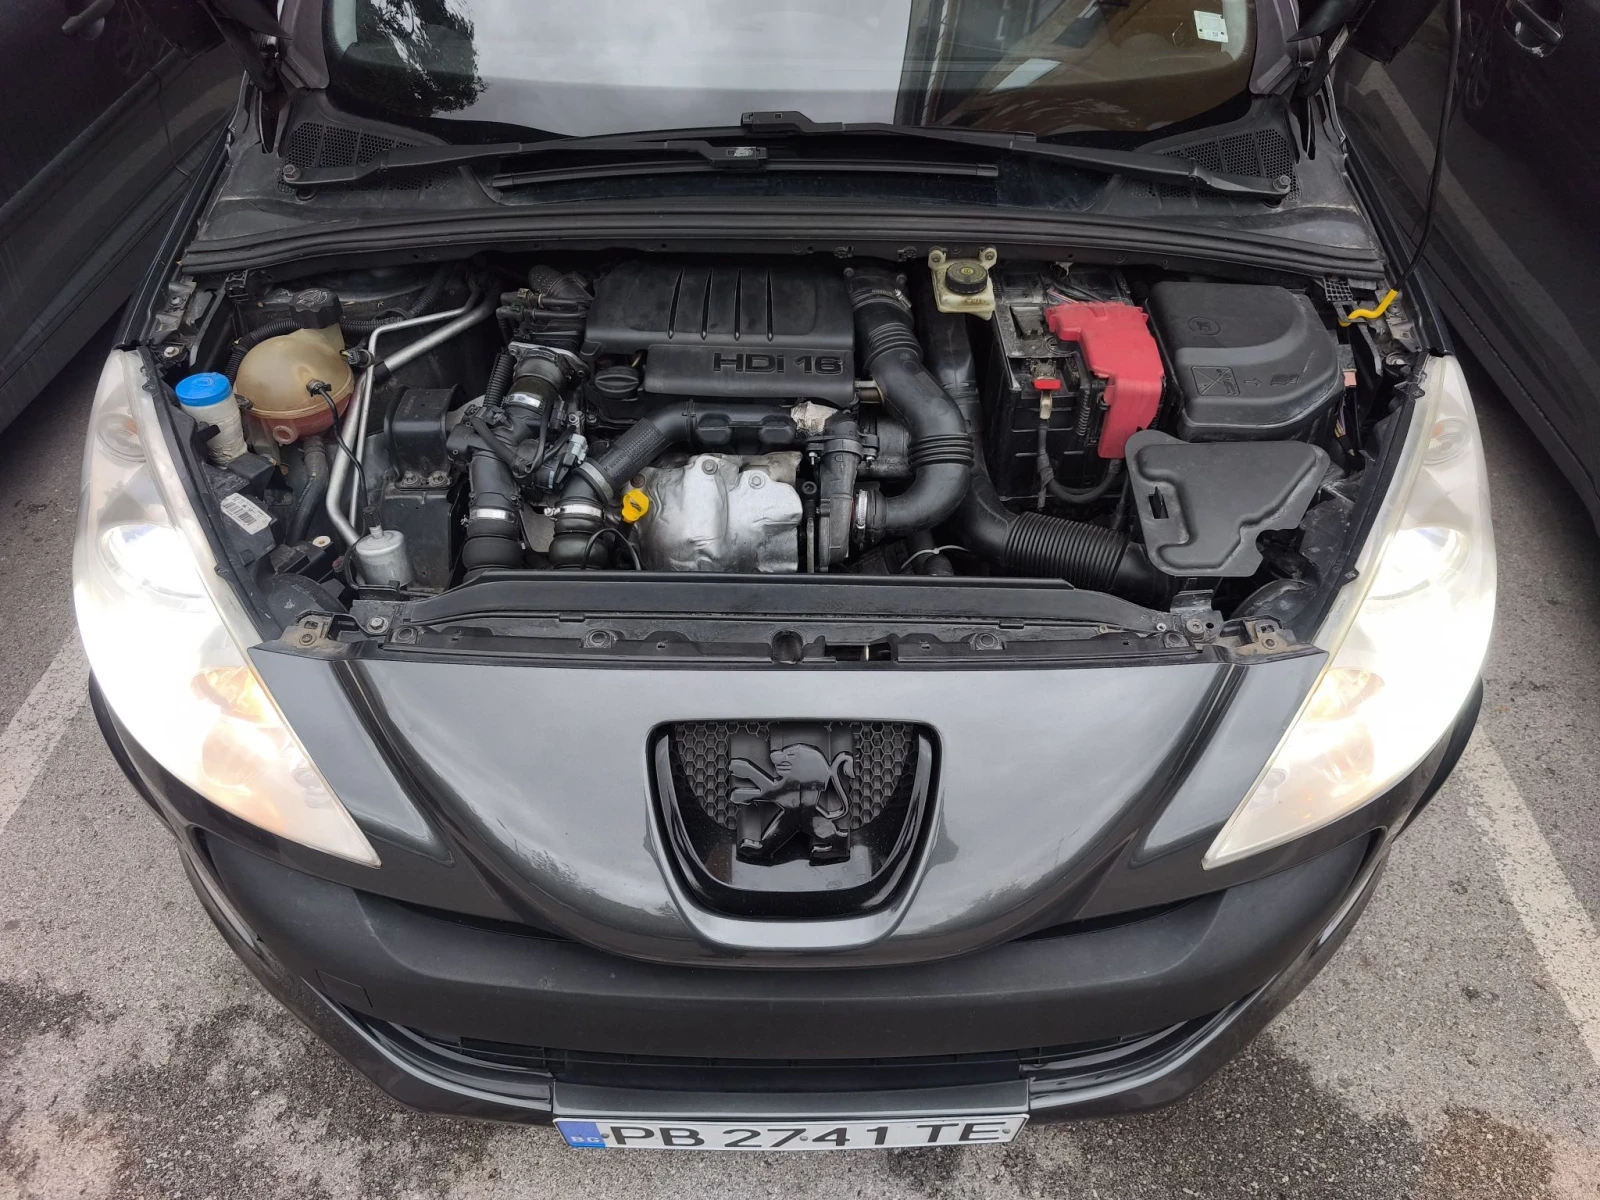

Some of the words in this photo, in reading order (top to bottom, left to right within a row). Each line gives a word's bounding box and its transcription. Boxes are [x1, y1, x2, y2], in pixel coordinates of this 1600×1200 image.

[713, 352, 785, 373] HDi
[794, 355, 844, 376] 16
[610, 1126, 705, 1147] PB
[722, 1126, 889, 1148] 2741
[916, 1121, 1007, 1143] TE
